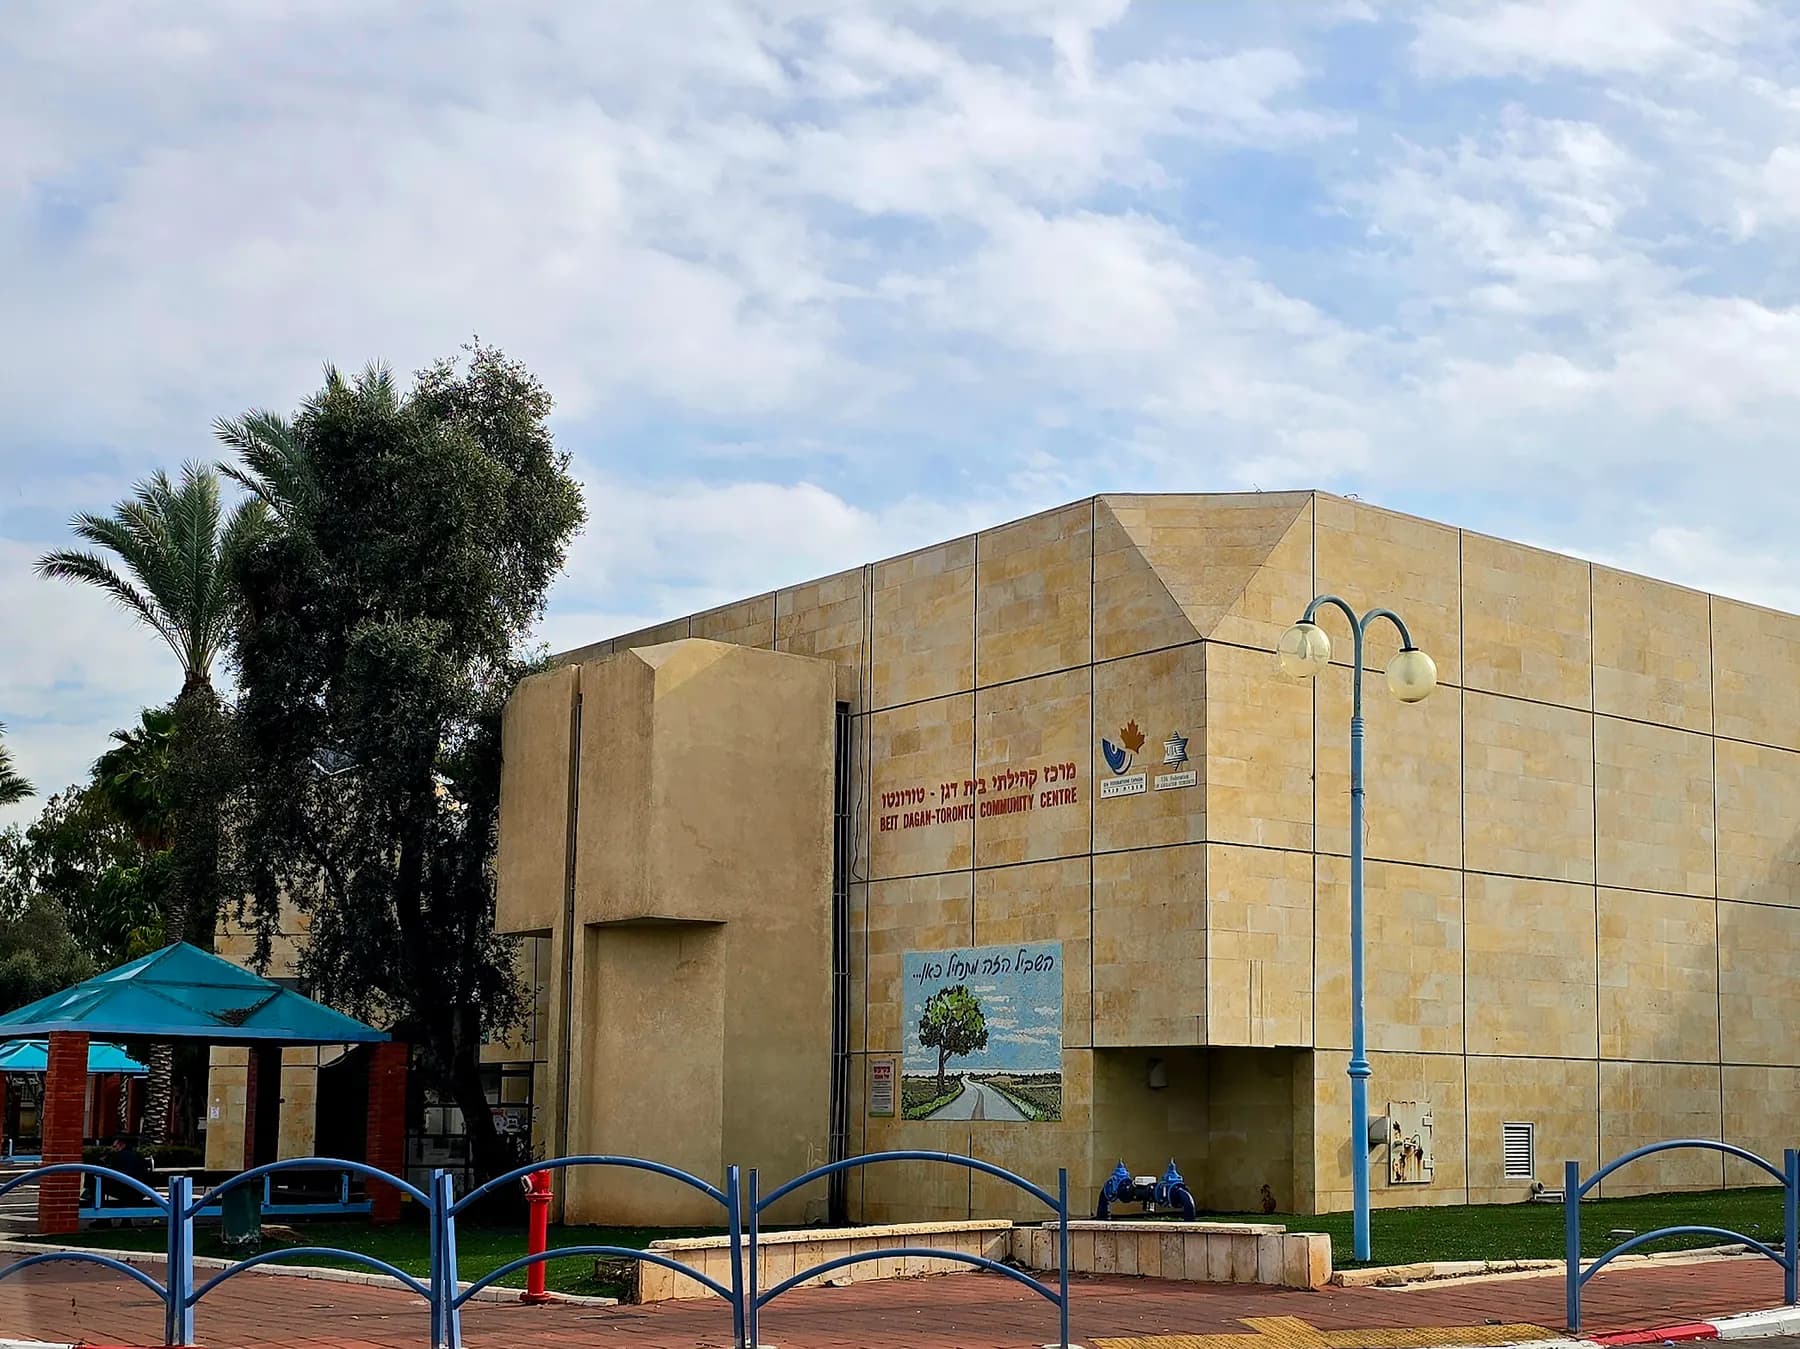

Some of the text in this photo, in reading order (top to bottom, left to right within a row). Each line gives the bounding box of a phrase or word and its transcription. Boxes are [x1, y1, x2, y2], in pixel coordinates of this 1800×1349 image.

[992, 768, 1038, 791] קהילתי
[1043, 762, 1077, 783] מרכז
[881, 787, 925, 809] טורונטו
[940, 782, 958, 804] דגן
[963, 777, 987, 797] בית
[880, 814, 899, 832] BEIT
[980, 794, 1034, 818] COMMUNITY
[1040, 787, 1077, 808] CENTRE
[946, 953, 979, 981] מתחיל
[982, 955, 1011, 975] הזה
[1014, 948, 1054, 975] השביל
